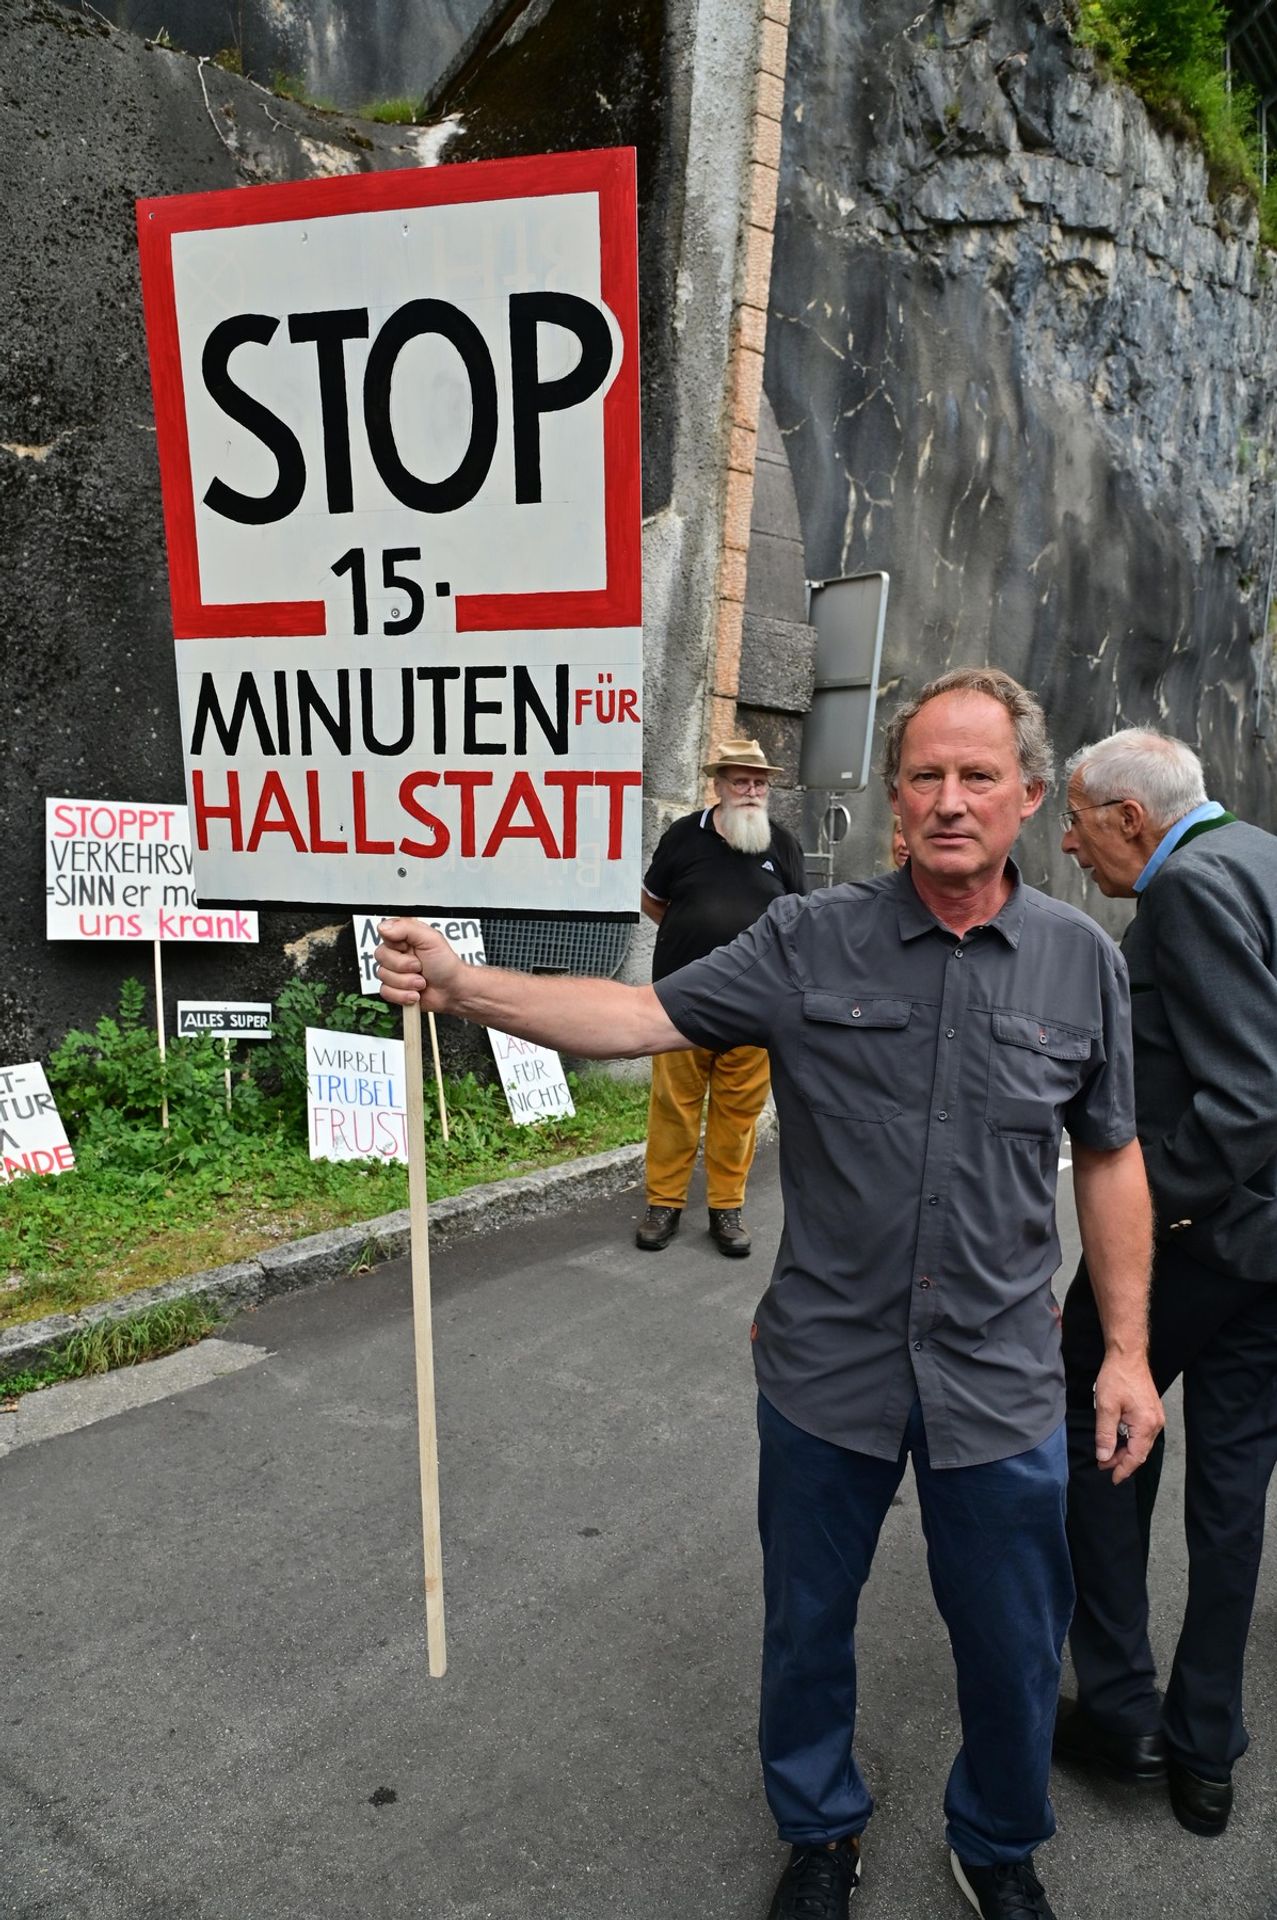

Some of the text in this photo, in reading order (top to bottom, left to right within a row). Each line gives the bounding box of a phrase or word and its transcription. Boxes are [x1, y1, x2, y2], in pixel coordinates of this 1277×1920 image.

[202, 292, 614, 525] STOP
[190, 664, 641, 756] MINUTEN FÜR
[54, 805, 175, 840] STOPPT
[192, 769, 642, 860] HALLSTATT
[122, 885, 151, 907] er
[79, 908, 251, 940] uns krank
[184, 1013, 267, 1028] ALLES SUPER
[313, 1046, 395, 1076] WIRBEL
[513, 1060, 551, 1085] FÜR
[311, 1074, 402, 1108] TRUBEL
[509, 1083, 570, 1114] NICHTS
[313, 1107, 408, 1156] FRUST
